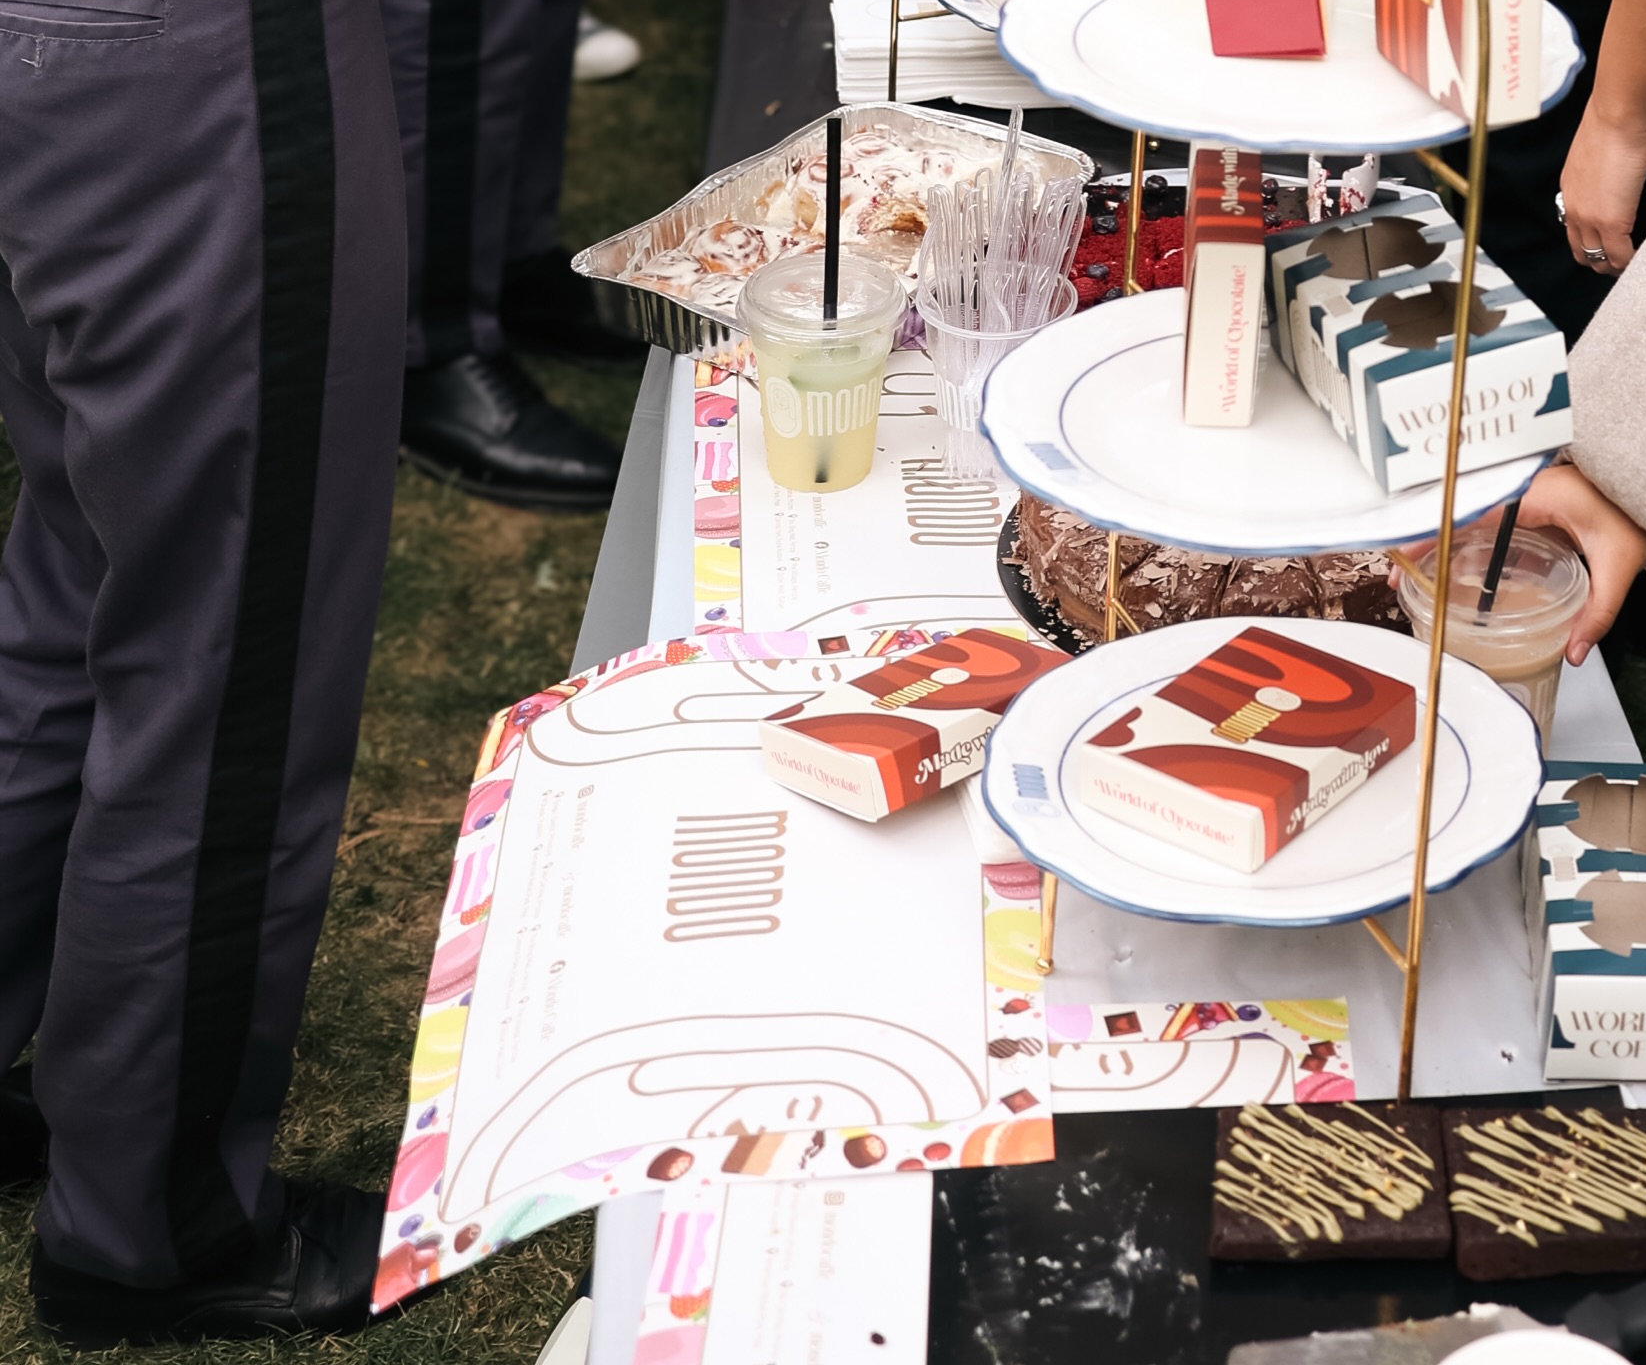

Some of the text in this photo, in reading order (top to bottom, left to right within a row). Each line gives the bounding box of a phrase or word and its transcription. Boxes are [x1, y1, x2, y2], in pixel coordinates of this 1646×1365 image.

[1217, 264, 1250, 414] World of Chocolate!
[806, 375, 878, 437] MOND
[1398, 387, 1500, 433] WOLD
[770, 750, 804, 774] World
[913, 740, 972, 785] Made
[1093, 777, 1236, 848] World of Chocolate!
